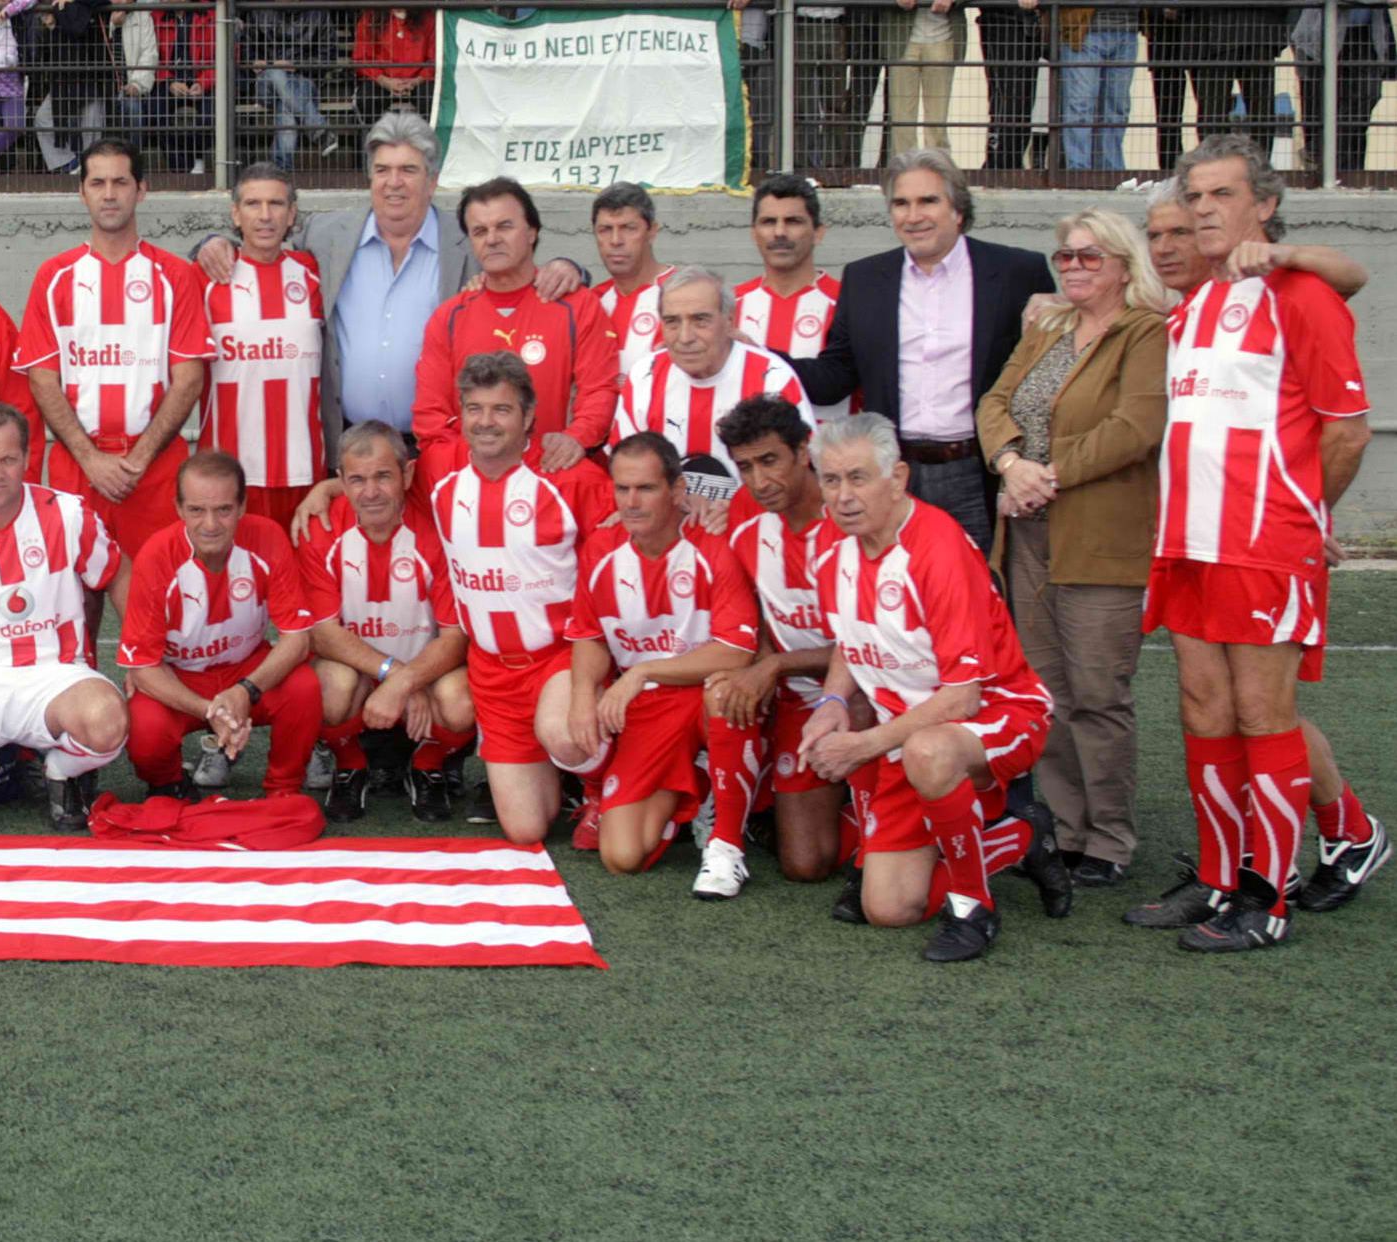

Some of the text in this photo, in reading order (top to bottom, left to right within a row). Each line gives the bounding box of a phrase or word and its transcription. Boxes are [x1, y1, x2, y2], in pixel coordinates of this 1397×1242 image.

[602, 29, 709, 55] ΕΥΓΕΝΕΙΑΣ
[505, 140, 562, 162] ΕΤΟΣ
[552, 164, 619, 187] 1937
